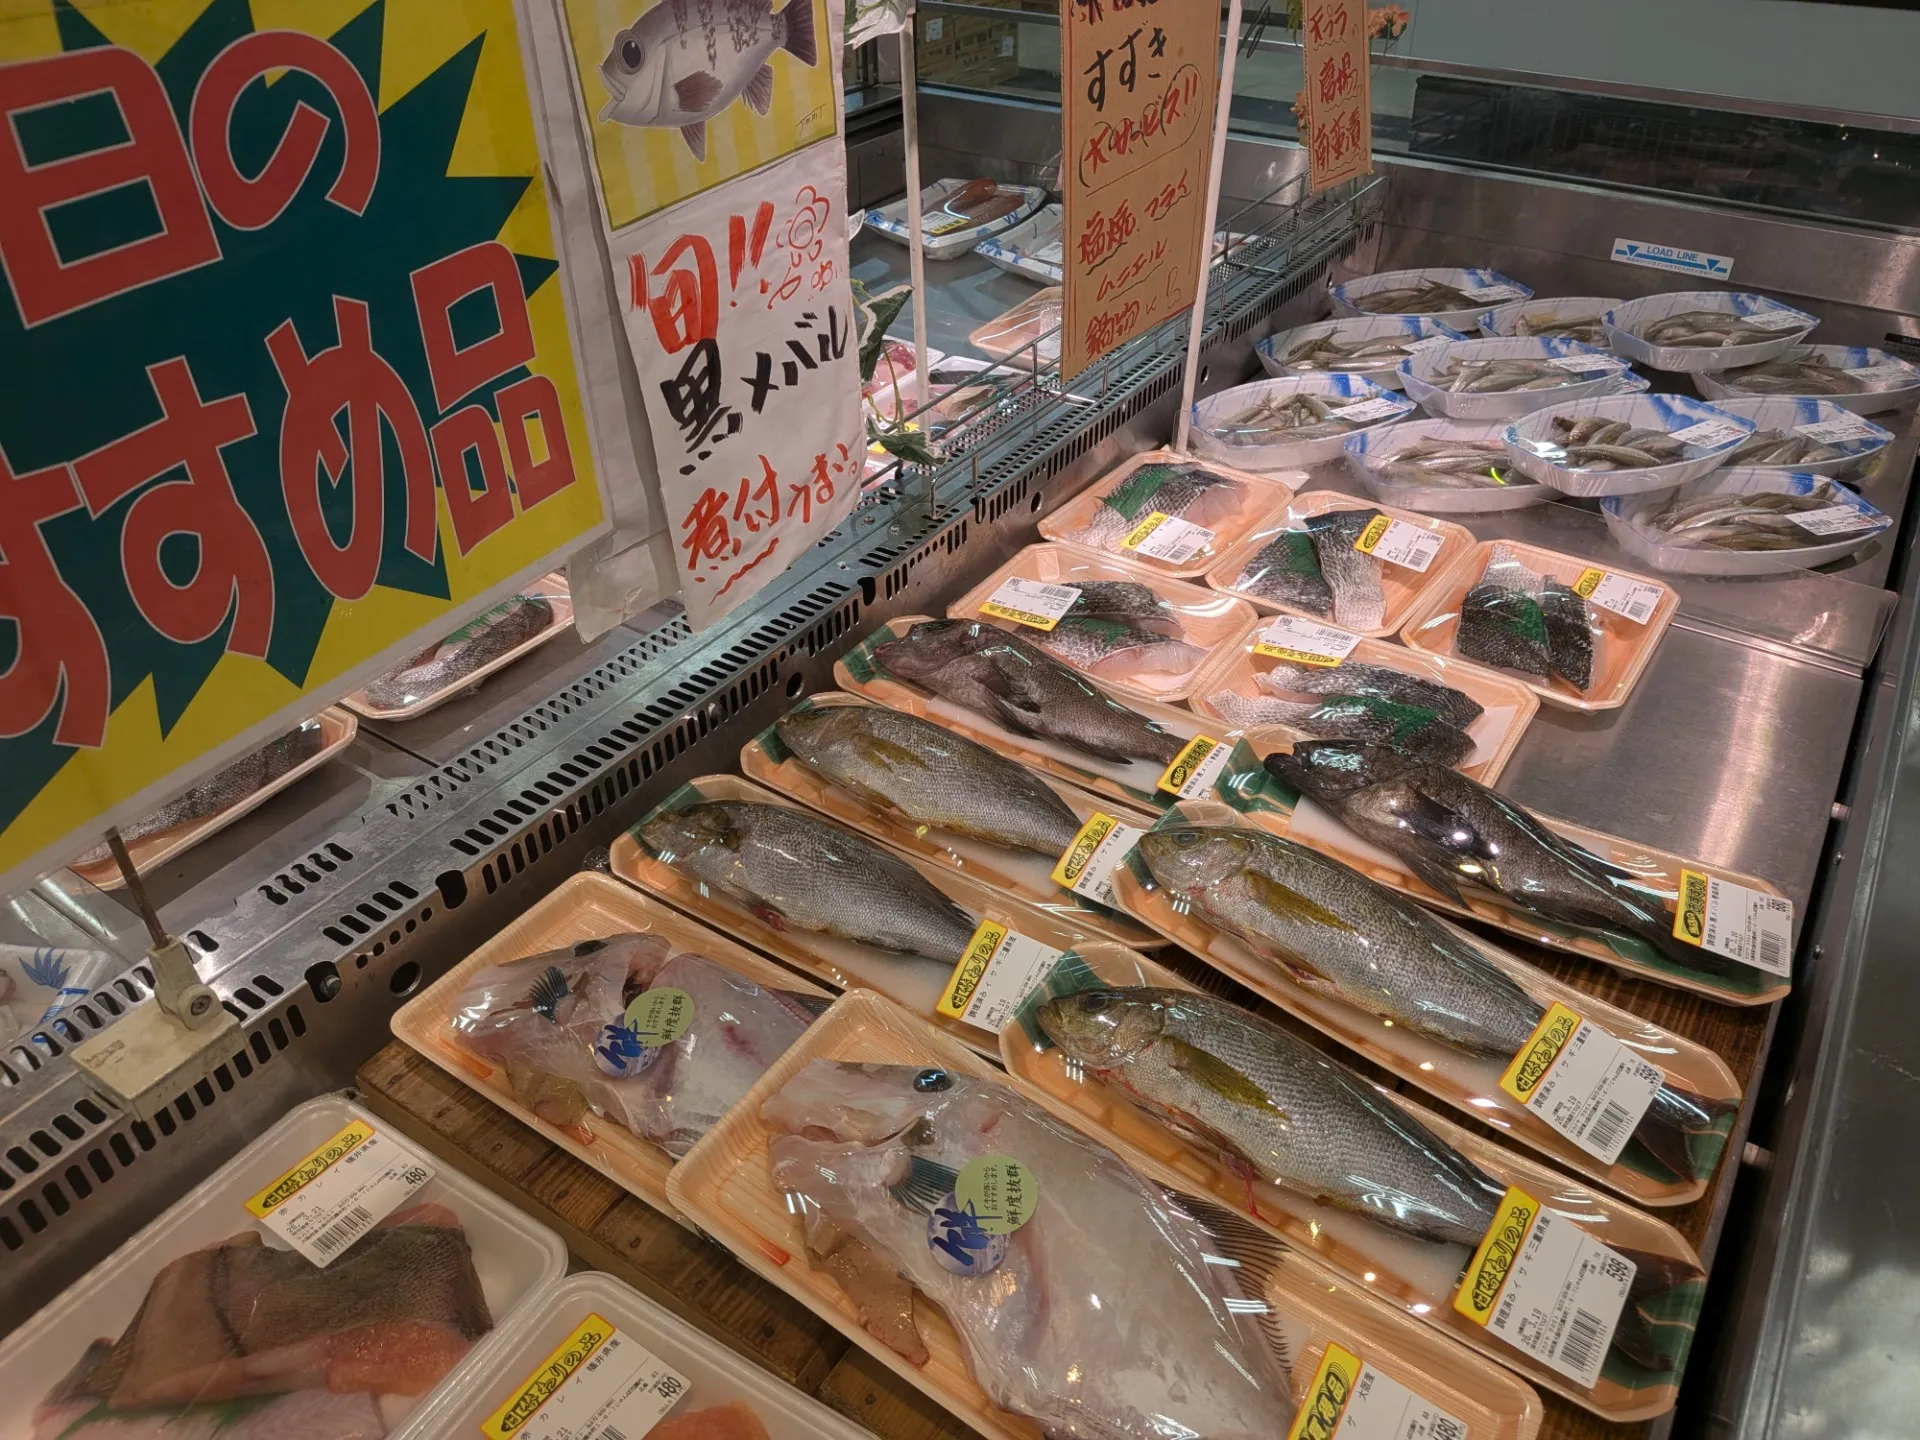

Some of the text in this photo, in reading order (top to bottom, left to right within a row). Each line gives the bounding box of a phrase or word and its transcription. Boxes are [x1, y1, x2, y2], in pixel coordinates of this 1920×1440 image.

[1083, 20, 1167, 112] すずき
[0, 29, 381, 330] 日の
[1097, 238, 1167, 301] ムニエル
[1646, 245, 1700, 262] LOAD LINE
[660, 304, 849, 475] 黒メバル
[661, 994, 686, 1041] 鮮度抜群
[1516, 1016, 1574, 1092] 日替わりの品
[405, 1167, 427, 1187] 480
[1005, 1163, 1023, 1226] 鮮度抜群
[1472, 1206, 1530, 1311] 日替わりの品
[1494, 1292, 1517, 1330] 調理済み
[1529, 1215, 1551, 1252] 三重県産
[1605, 1258, 1628, 1282] 598
[501, 1332, 602, 1432] 日替わりの品
[586, 1339, 621, 1373] 福井県産
[658, 1376, 681, 1399] 480
[1357, 1372, 1375, 1401] 大阪産
